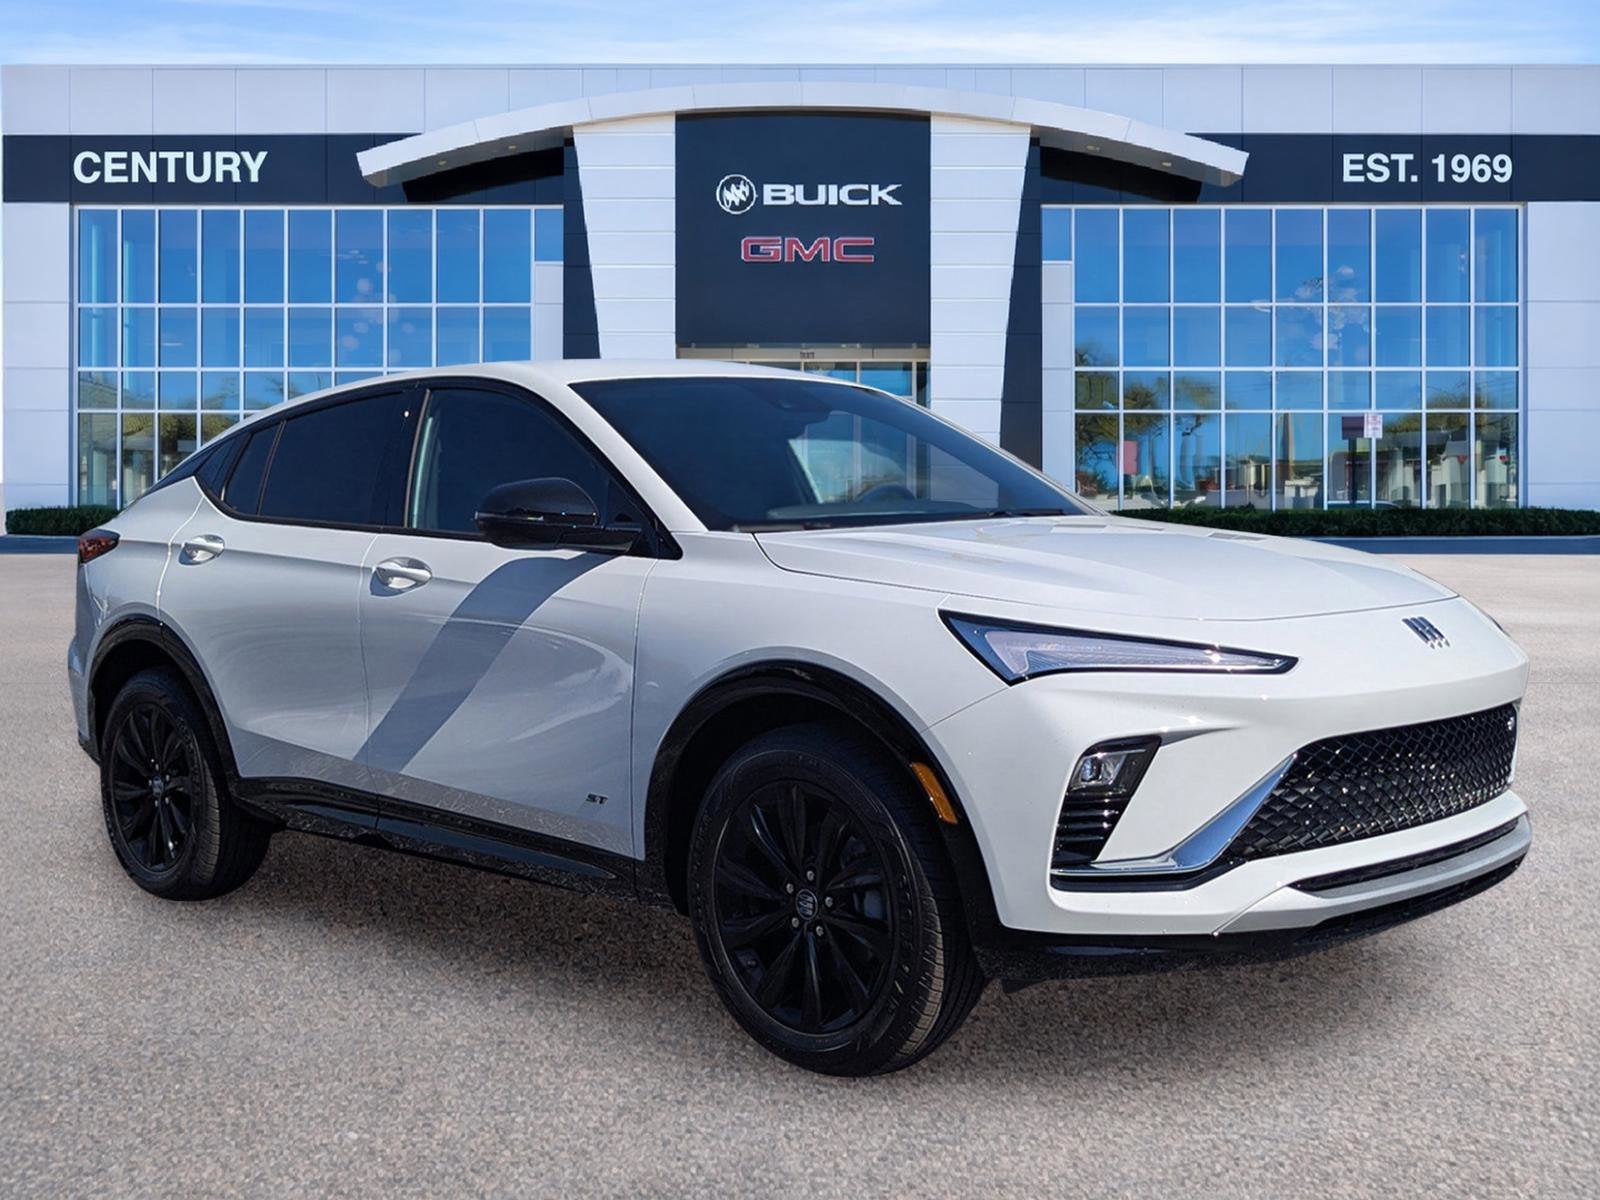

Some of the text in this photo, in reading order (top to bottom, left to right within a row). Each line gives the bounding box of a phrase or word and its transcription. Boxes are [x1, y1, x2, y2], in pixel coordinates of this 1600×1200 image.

[73, 150, 269, 184] CENTURY
[1342, 152, 1513, 183] EST. 1969
[762, 184, 903, 206] BUICK
[740, 236, 875, 263] GMC
[585, 793, 608, 805] ST
